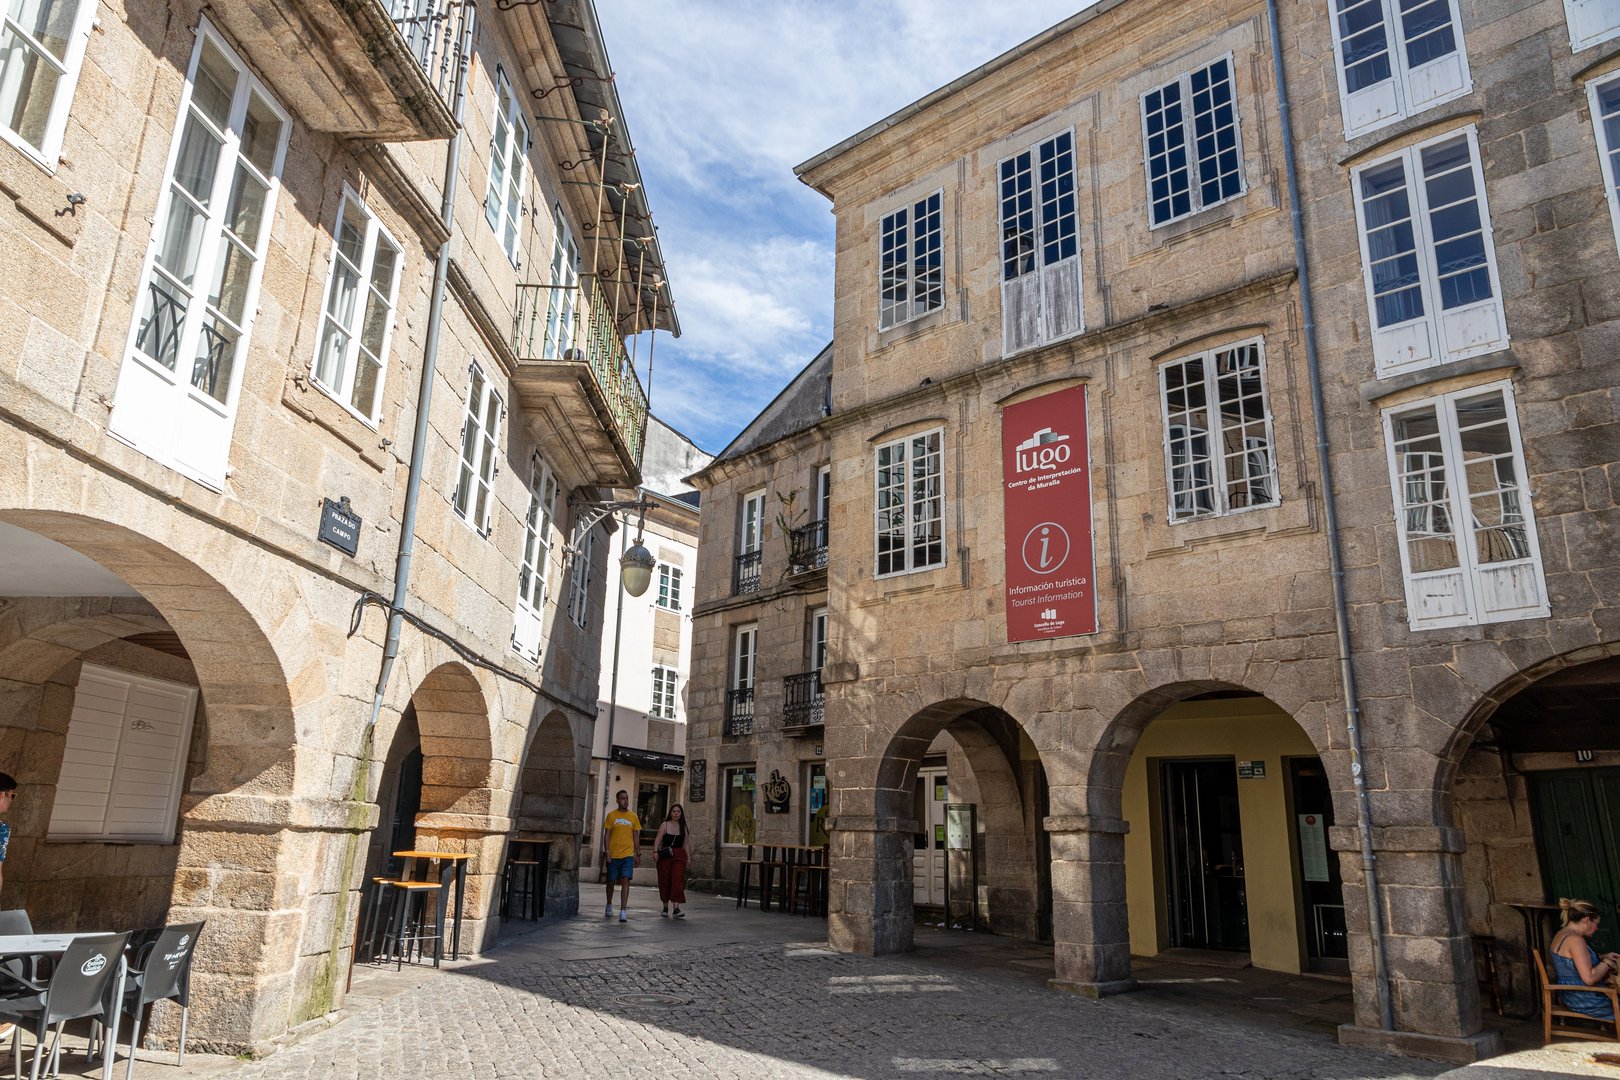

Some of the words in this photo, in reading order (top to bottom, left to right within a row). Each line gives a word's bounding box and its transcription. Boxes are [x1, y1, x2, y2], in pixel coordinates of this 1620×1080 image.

[1016, 444, 1071, 473] lugo
[1008, 479, 1028, 488] Centro
[1037, 467, 1081, 481] Interpretación
[1036, 479, 1061, 489] Muralla
[332, 511, 348, 525] PRAZA
[348, 521, 356, 530] DO
[332, 526, 351, 540] CAMPO
[1009, 582, 1054, 595] Información
[1055, 577, 1087, 588] turística
[1012, 597, 1037, 607] Tourist
[1037, 591, 1083, 603] Information
[1577, 750, 1592, 761] 10
